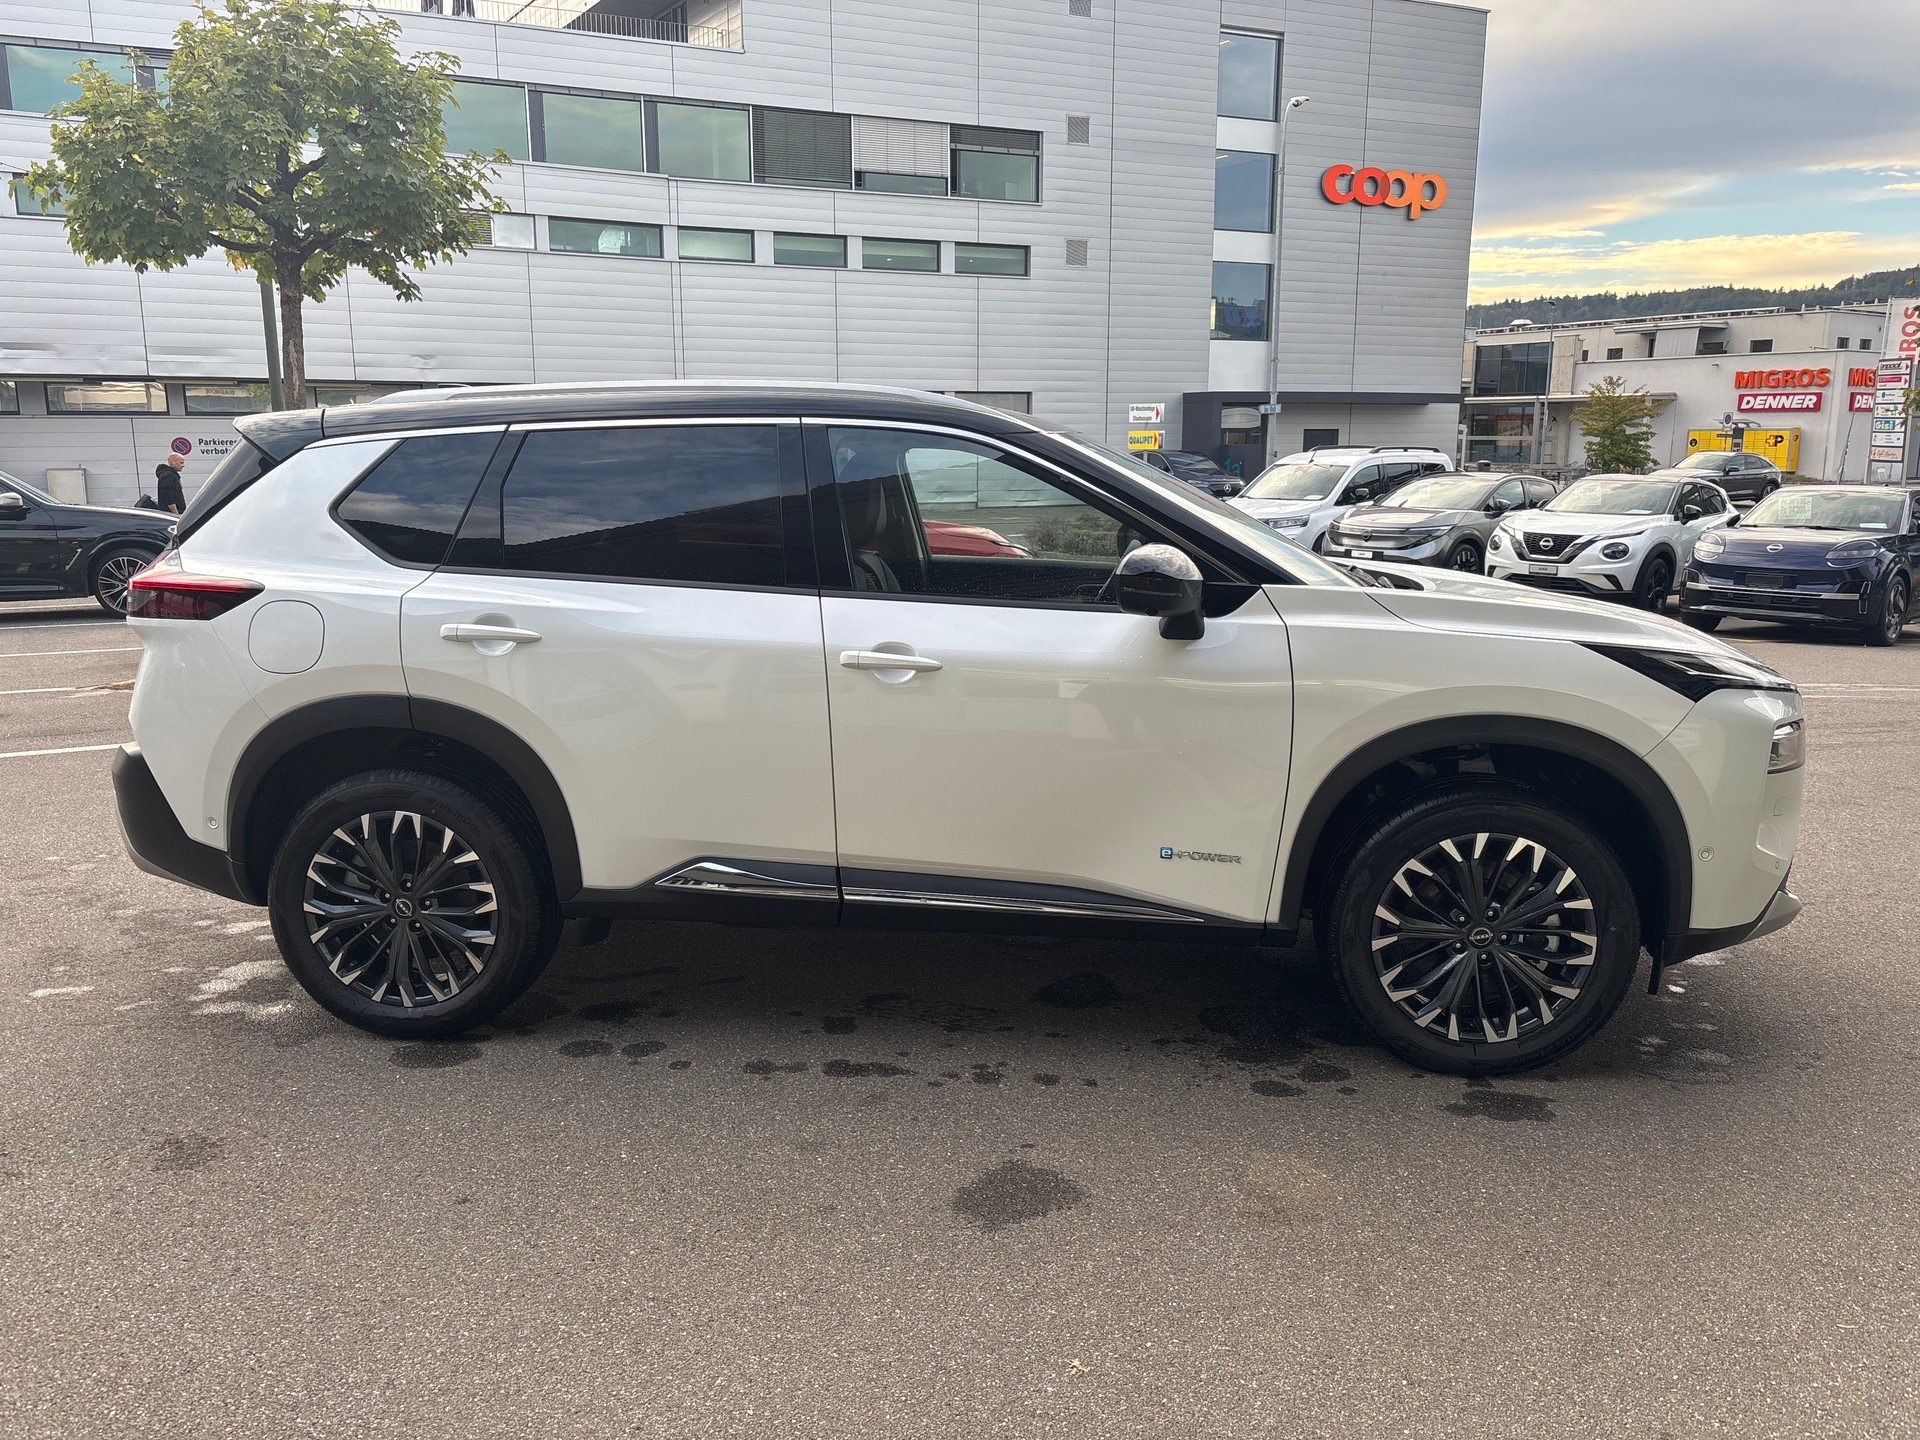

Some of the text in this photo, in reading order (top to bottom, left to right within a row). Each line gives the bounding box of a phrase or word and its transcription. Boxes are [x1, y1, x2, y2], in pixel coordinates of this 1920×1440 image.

[1321, 164, 1448, 220] coop
[1734, 368, 1831, 389] MIGROS
[1740, 395, 1817, 409] DENNER
[1876, 421, 1894, 430] Gisi
[1129, 436, 1153, 445] QUALIPET
[200, 447, 230, 455] verbot
